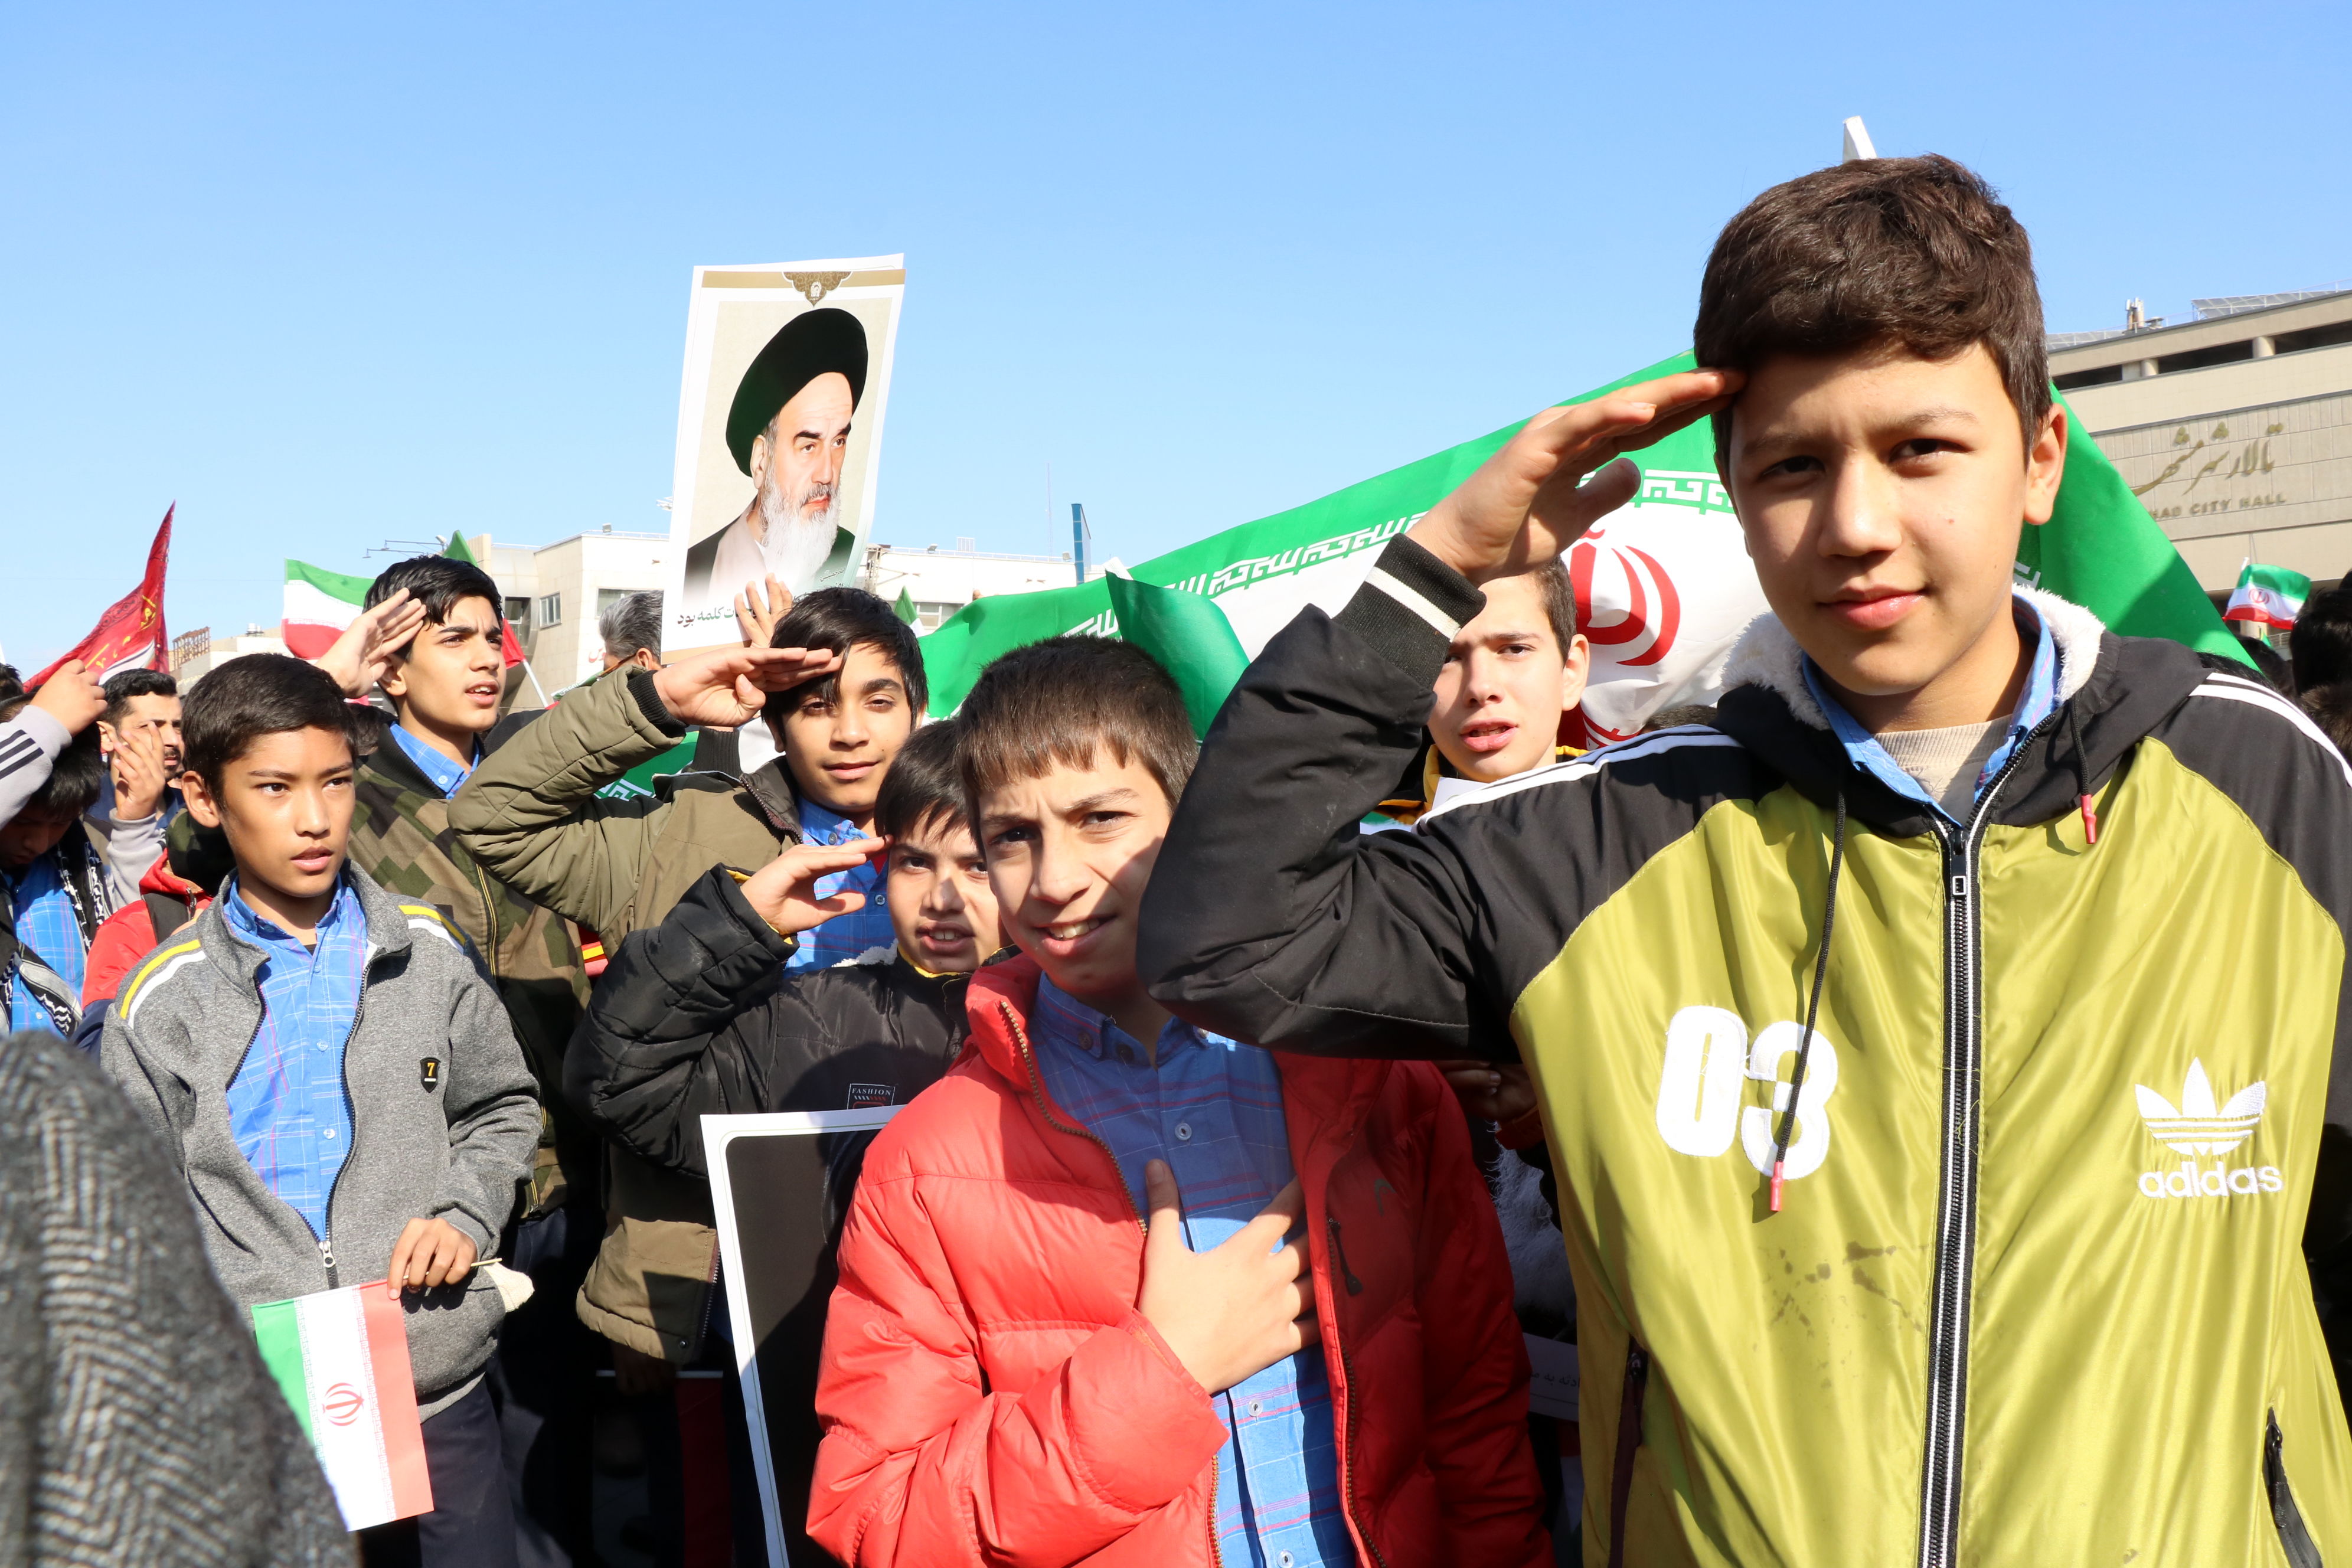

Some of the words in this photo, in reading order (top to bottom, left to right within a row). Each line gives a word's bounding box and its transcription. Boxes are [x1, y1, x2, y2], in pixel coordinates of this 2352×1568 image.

[2190, 499, 2232, 515] CITY
[2239, 494, 2286, 509] HALL
[677, 613, 695, 628] بود
[697, 606, 725, 620] کلمه
[427, 1062, 436, 1077] 7
[1655, 1004, 1838, 1180] 03
[2138, 1161, 2284, 1198] adidas
